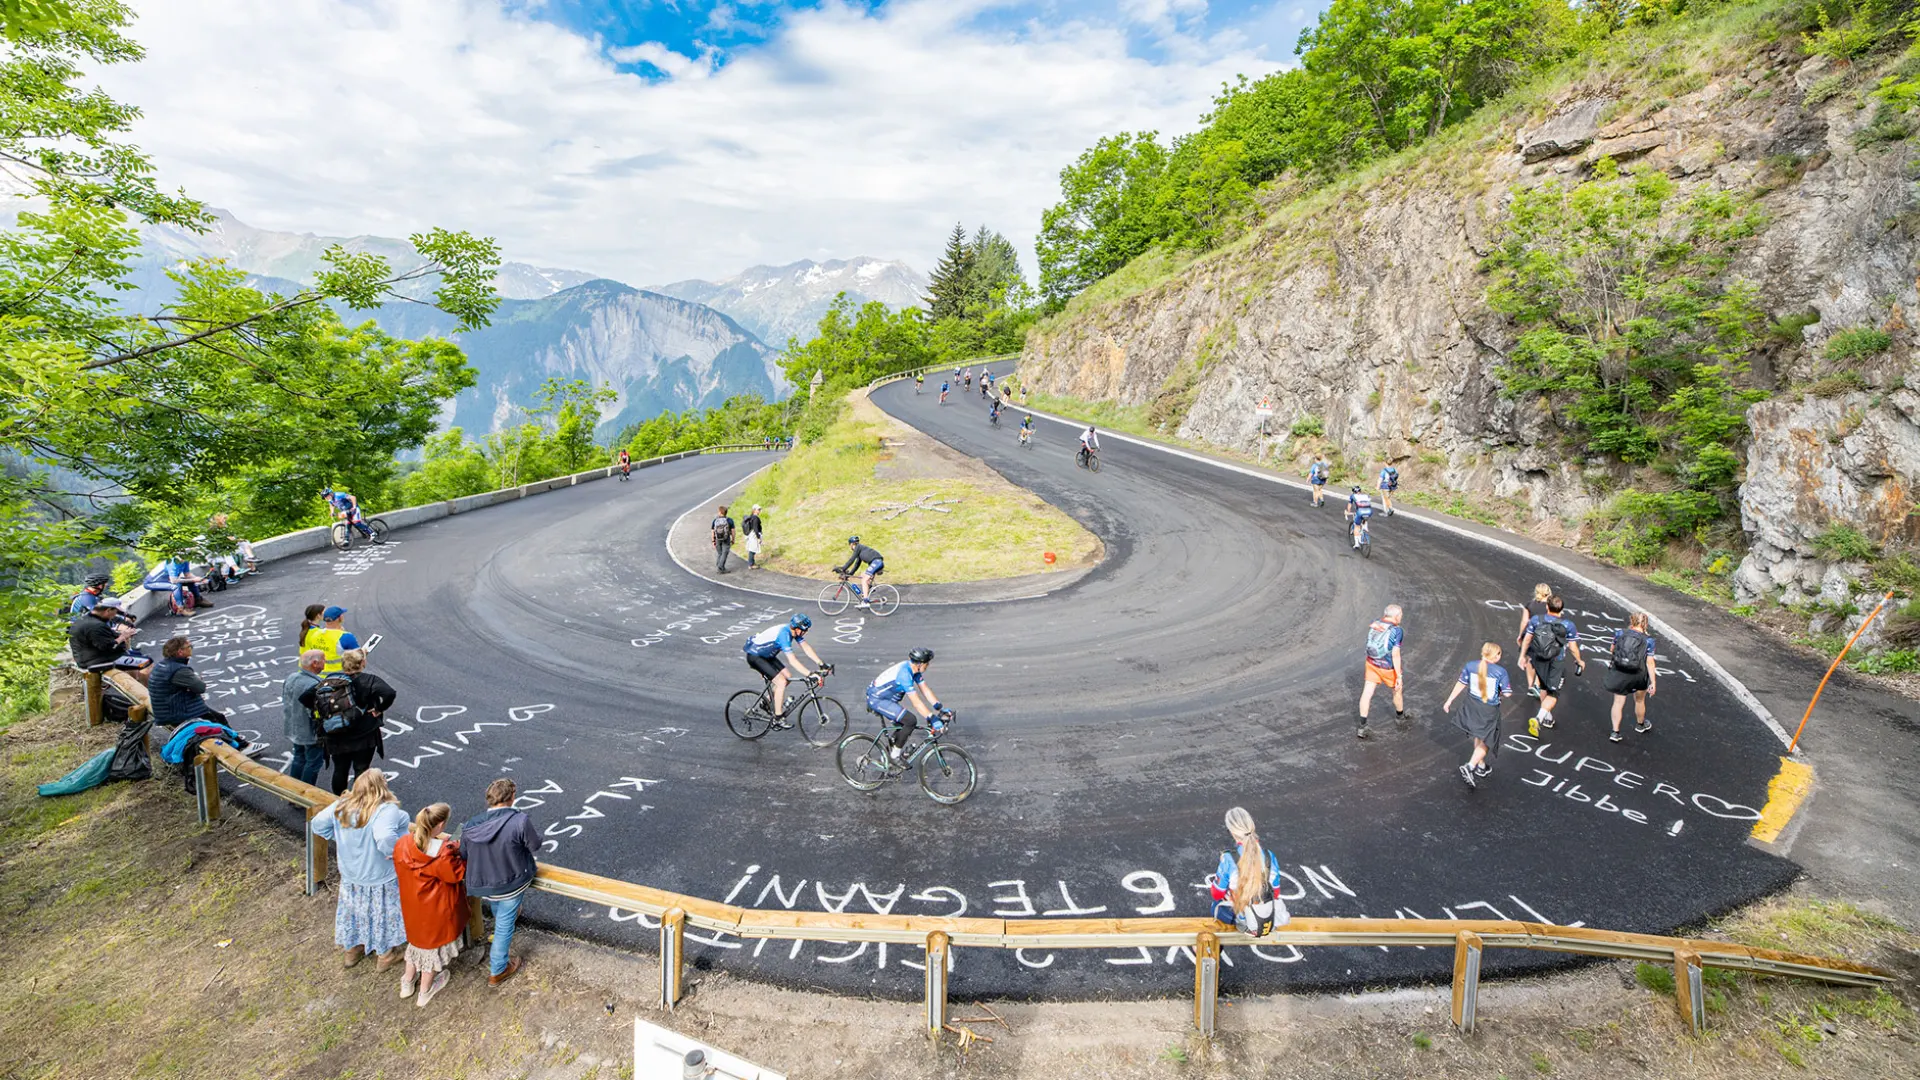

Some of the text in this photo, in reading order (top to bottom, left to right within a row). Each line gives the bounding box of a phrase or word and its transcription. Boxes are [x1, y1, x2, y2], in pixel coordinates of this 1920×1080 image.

[645, 602, 745, 636] MARGA
[717, 606, 793, 637] TRUDY
[1484, 599, 1624, 622] CHTAL
[136, 626, 281, 648] JURGN
[1503, 733, 1686, 805] SUPER
[724, 864, 967, 918] GAAN!
[990, 880, 1108, 917] TE
[1121, 870, 1176, 914] 6
